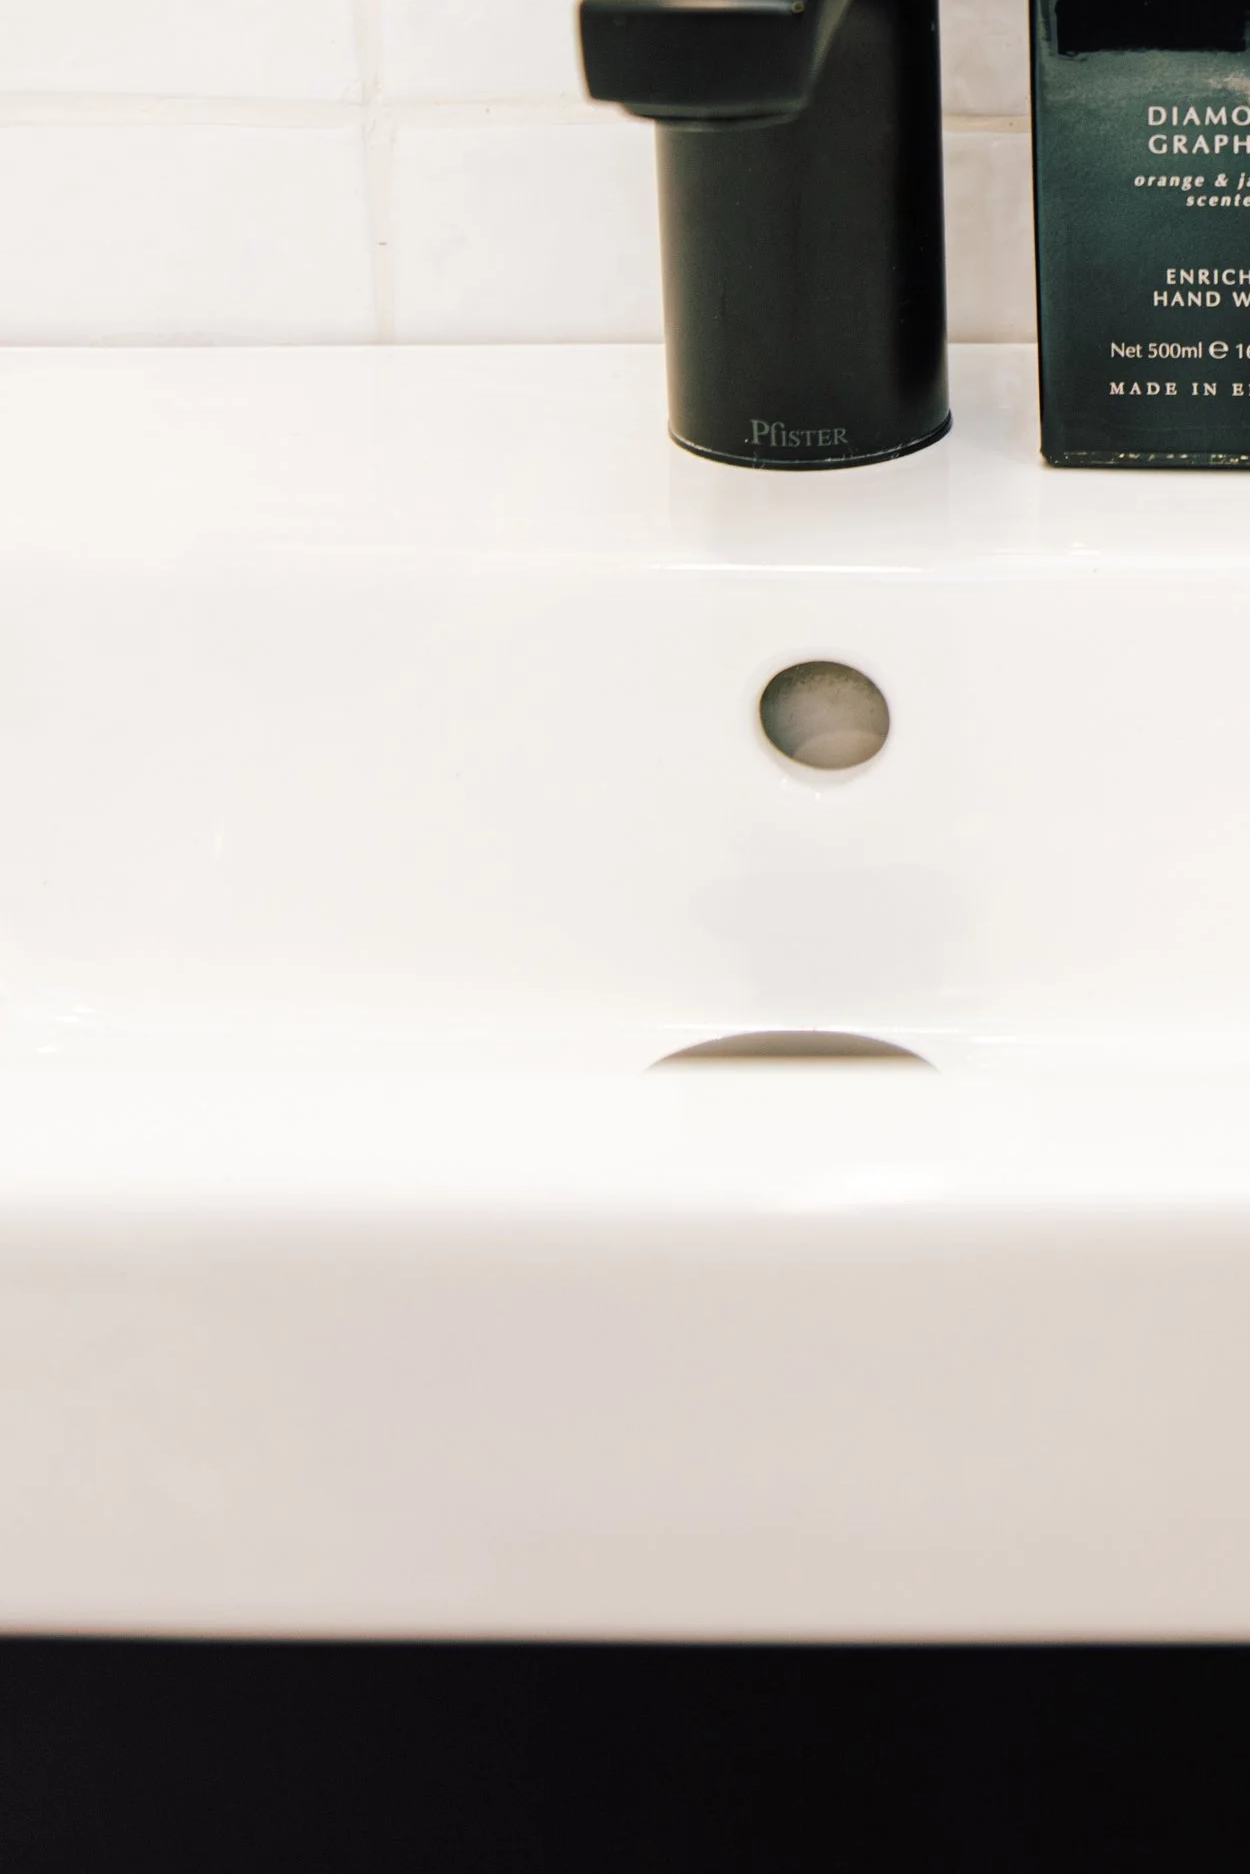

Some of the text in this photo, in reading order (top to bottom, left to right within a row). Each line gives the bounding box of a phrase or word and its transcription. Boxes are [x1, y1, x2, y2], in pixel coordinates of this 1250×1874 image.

[1134, 174, 1205, 190] orange
[1215, 173, 1228, 188] &
[1153, 290, 1222, 308] HAND
[1110, 342, 1143, 359] Net
[1147, 341, 1203, 359] 500ml
[1109, 382, 1178, 396] MADE
[1192, 383, 1218, 396] IN
